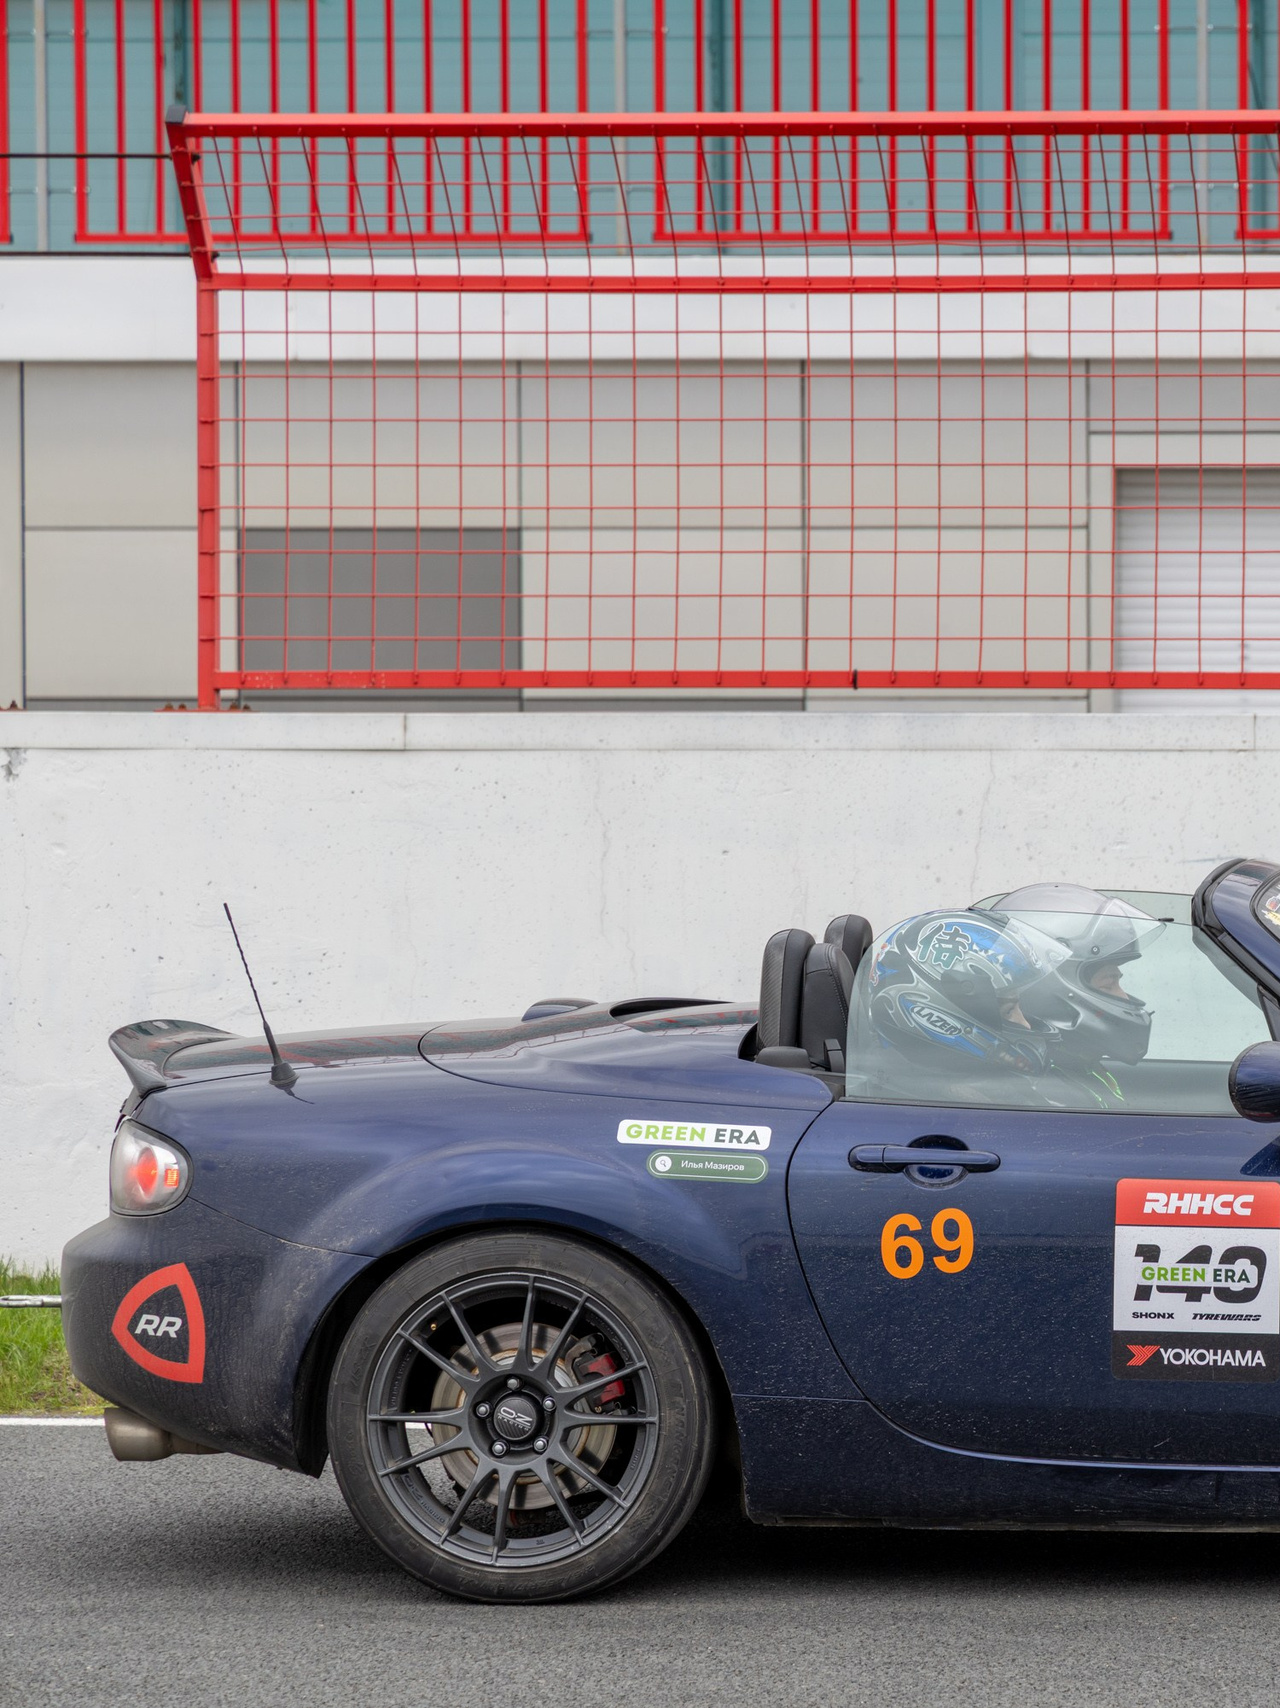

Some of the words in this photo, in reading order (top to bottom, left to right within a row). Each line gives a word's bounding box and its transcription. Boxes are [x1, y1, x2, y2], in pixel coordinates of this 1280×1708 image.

[915, 1006, 959, 1035] LAZER
[625, 1123, 706, 1142] GREEN
[714, 1128, 761, 1145] ERA
[681, 1160, 703, 1169] Илья
[704, 1160, 745, 1172] Мазиров
[1143, 1192, 1255, 1216] RHHCC
[880, 1207, 975, 1280] 69
[1141, 1265, 1206, 1282] GREEN
[1212, 1268, 1251, 1284] ERA
[134, 1313, 183, 1338] RR
[1131, 1311, 1175, 1320] SHONX
[1191, 1312, 1262, 1322] TYREWARS
[1159, 1347, 1267, 1367] YOKOHAMA
